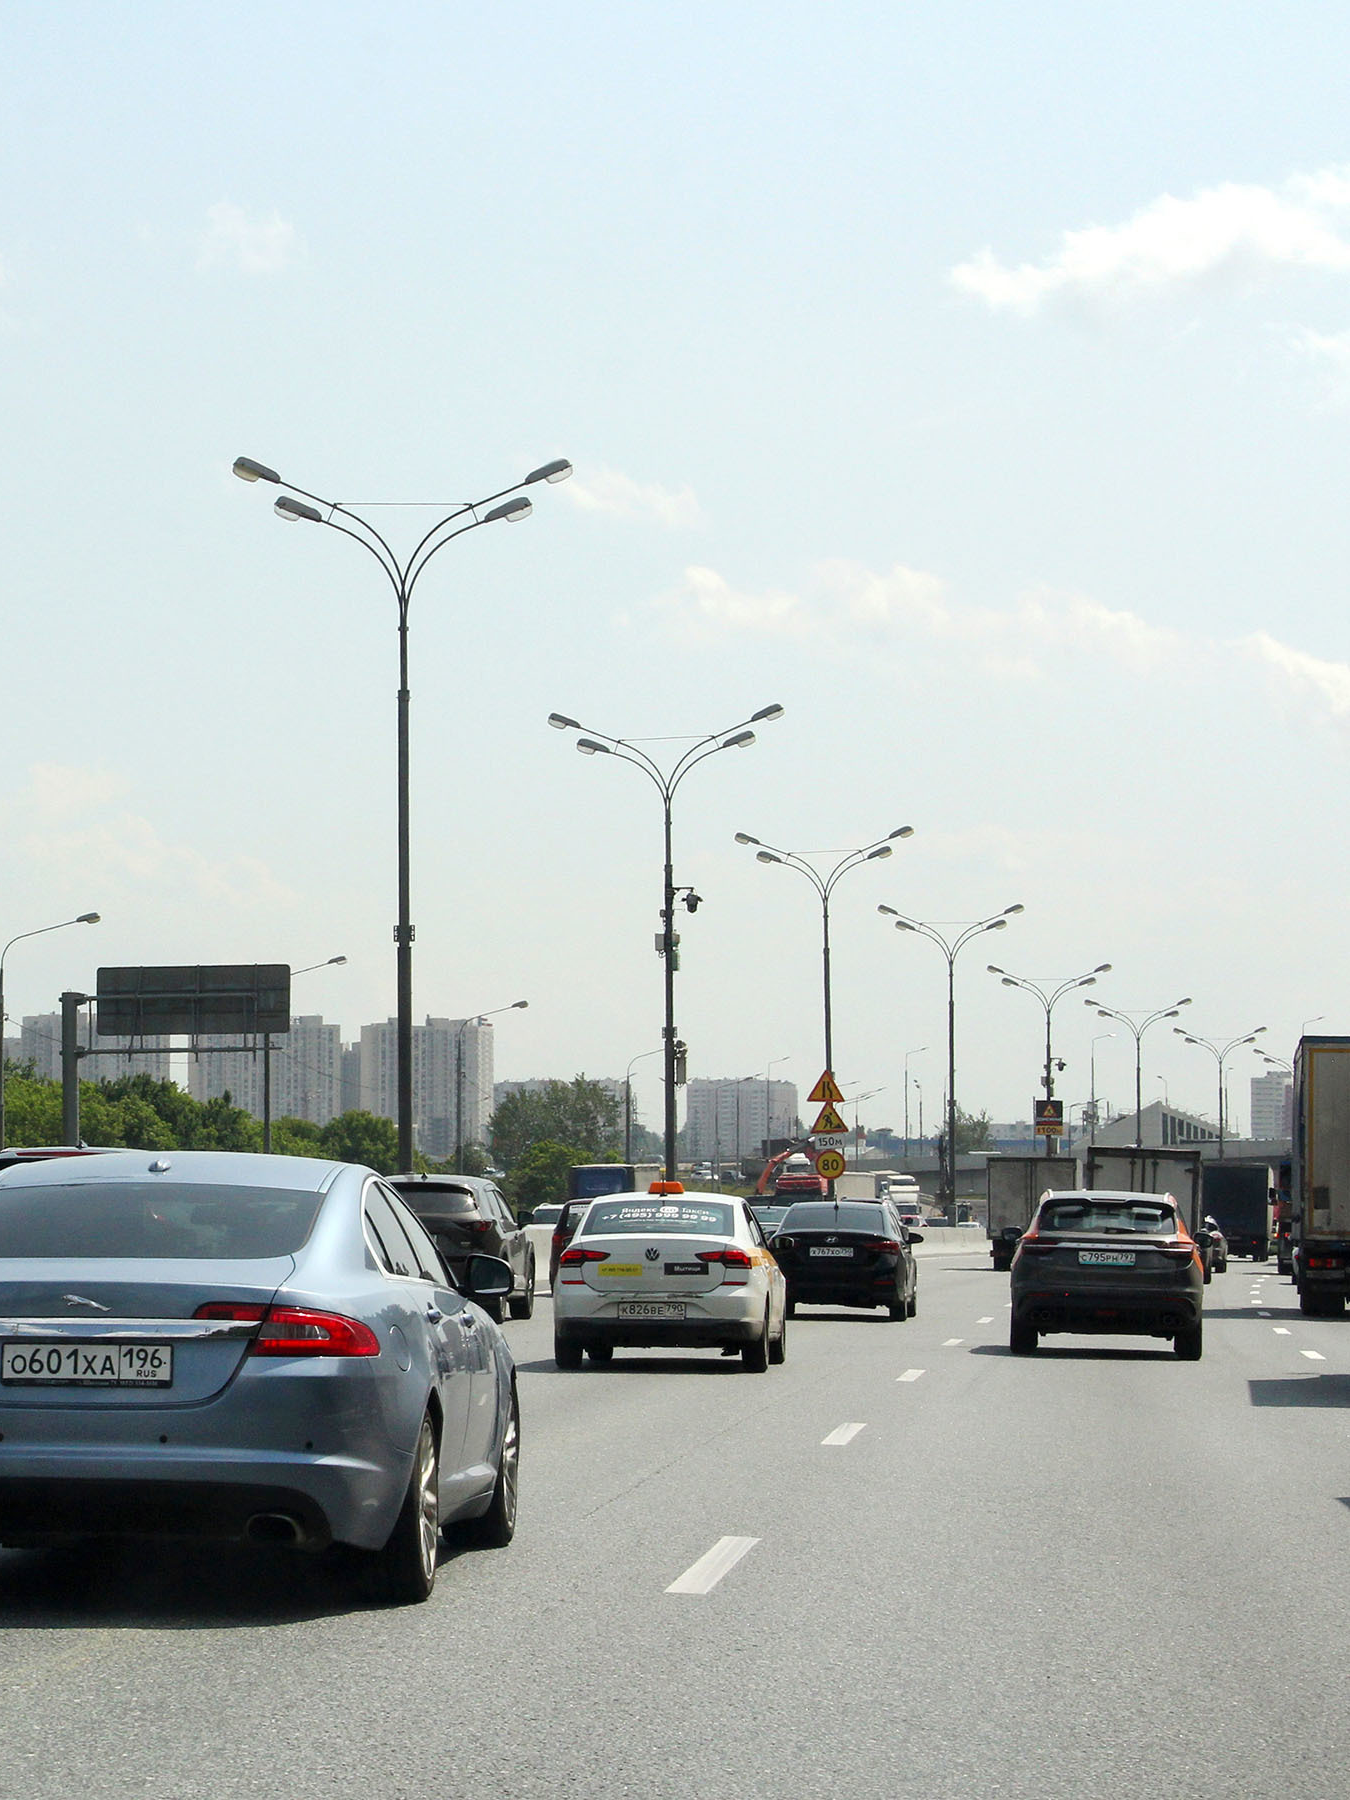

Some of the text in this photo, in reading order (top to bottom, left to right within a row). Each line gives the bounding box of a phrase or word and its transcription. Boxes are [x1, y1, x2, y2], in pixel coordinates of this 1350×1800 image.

[818, 1137, 843, 1146] 150м
[822, 1159, 839, 1171] 80
[621, 1304, 664, 1315] К826ВЕ
[11, 1348, 162, 1376] О601ХА 196
[136, 1370, 157, 1378] RUS
